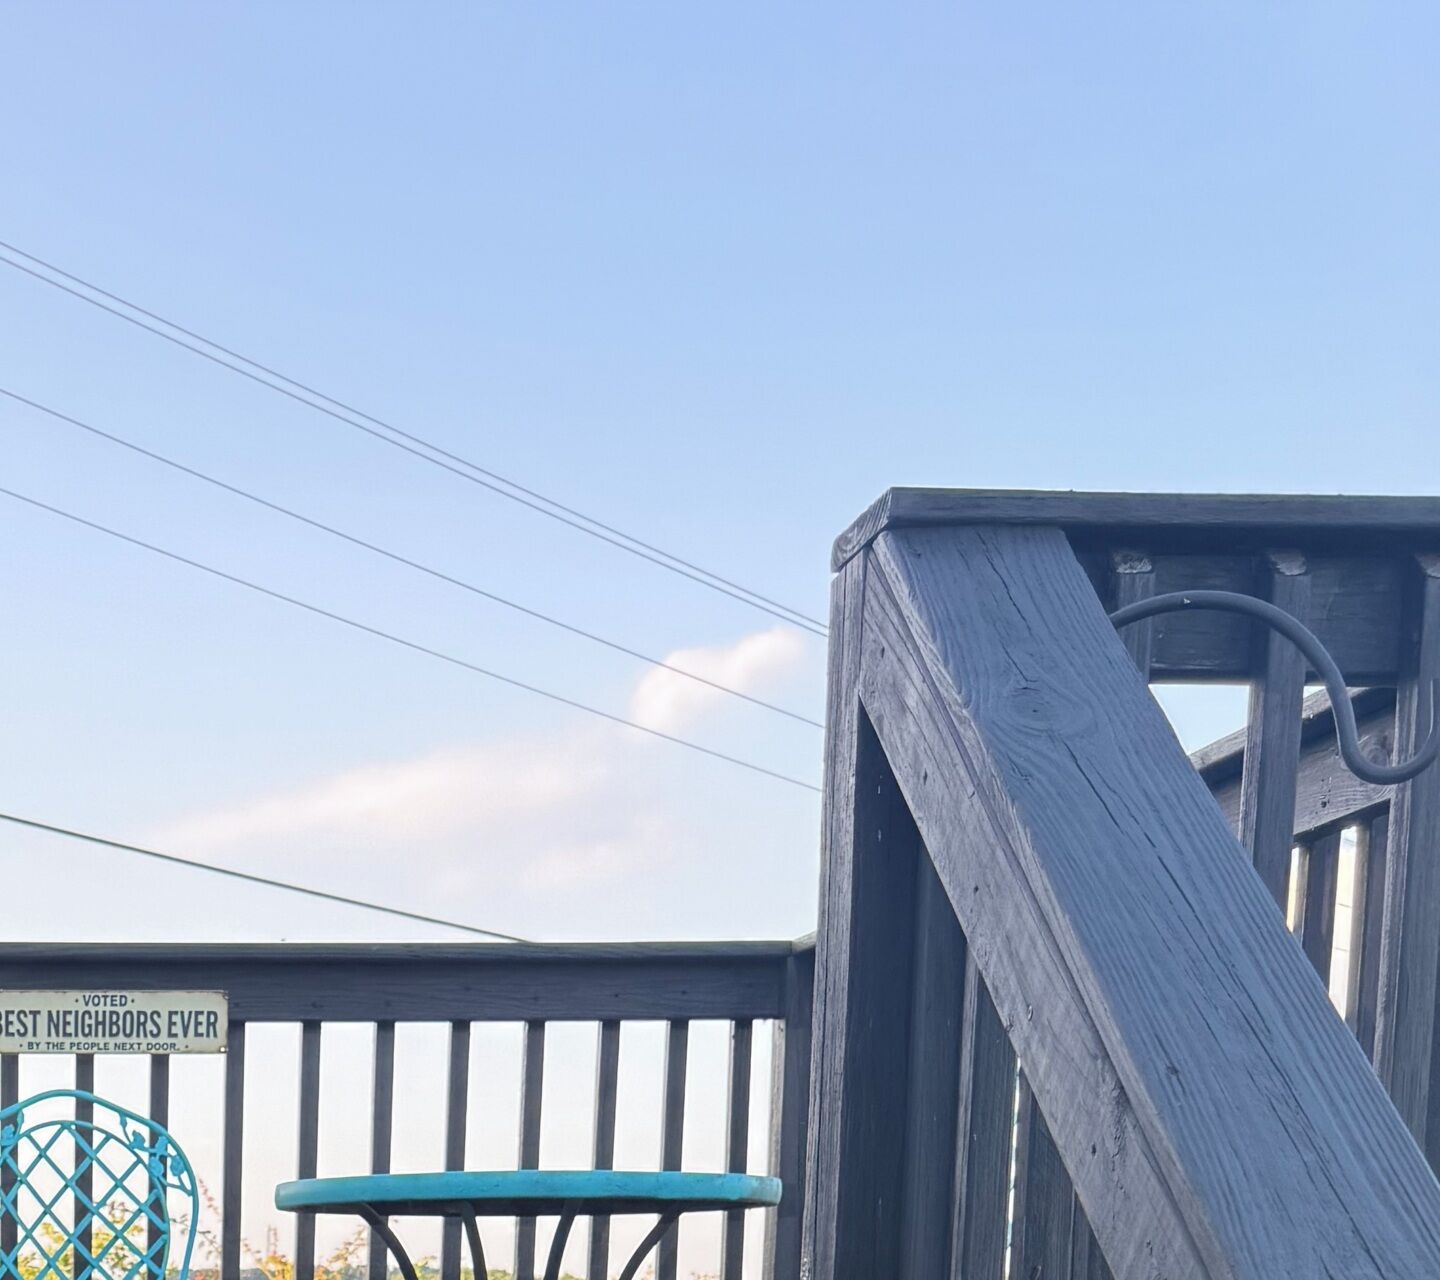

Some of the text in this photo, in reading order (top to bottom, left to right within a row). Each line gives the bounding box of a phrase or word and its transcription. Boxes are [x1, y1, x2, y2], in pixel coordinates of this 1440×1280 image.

[82, 994, 128, 1008] VOTED
[47, 1009, 162, 1039] NEIGHBORS
[167, 1010, 219, 1040] EVER
[27, 1041, 41, 1051] BY
[46, 1041, 65, 1051] THE
[69, 1041, 110, 1052] PEOPLE
[113, 1042, 143, 1052] NEXT
